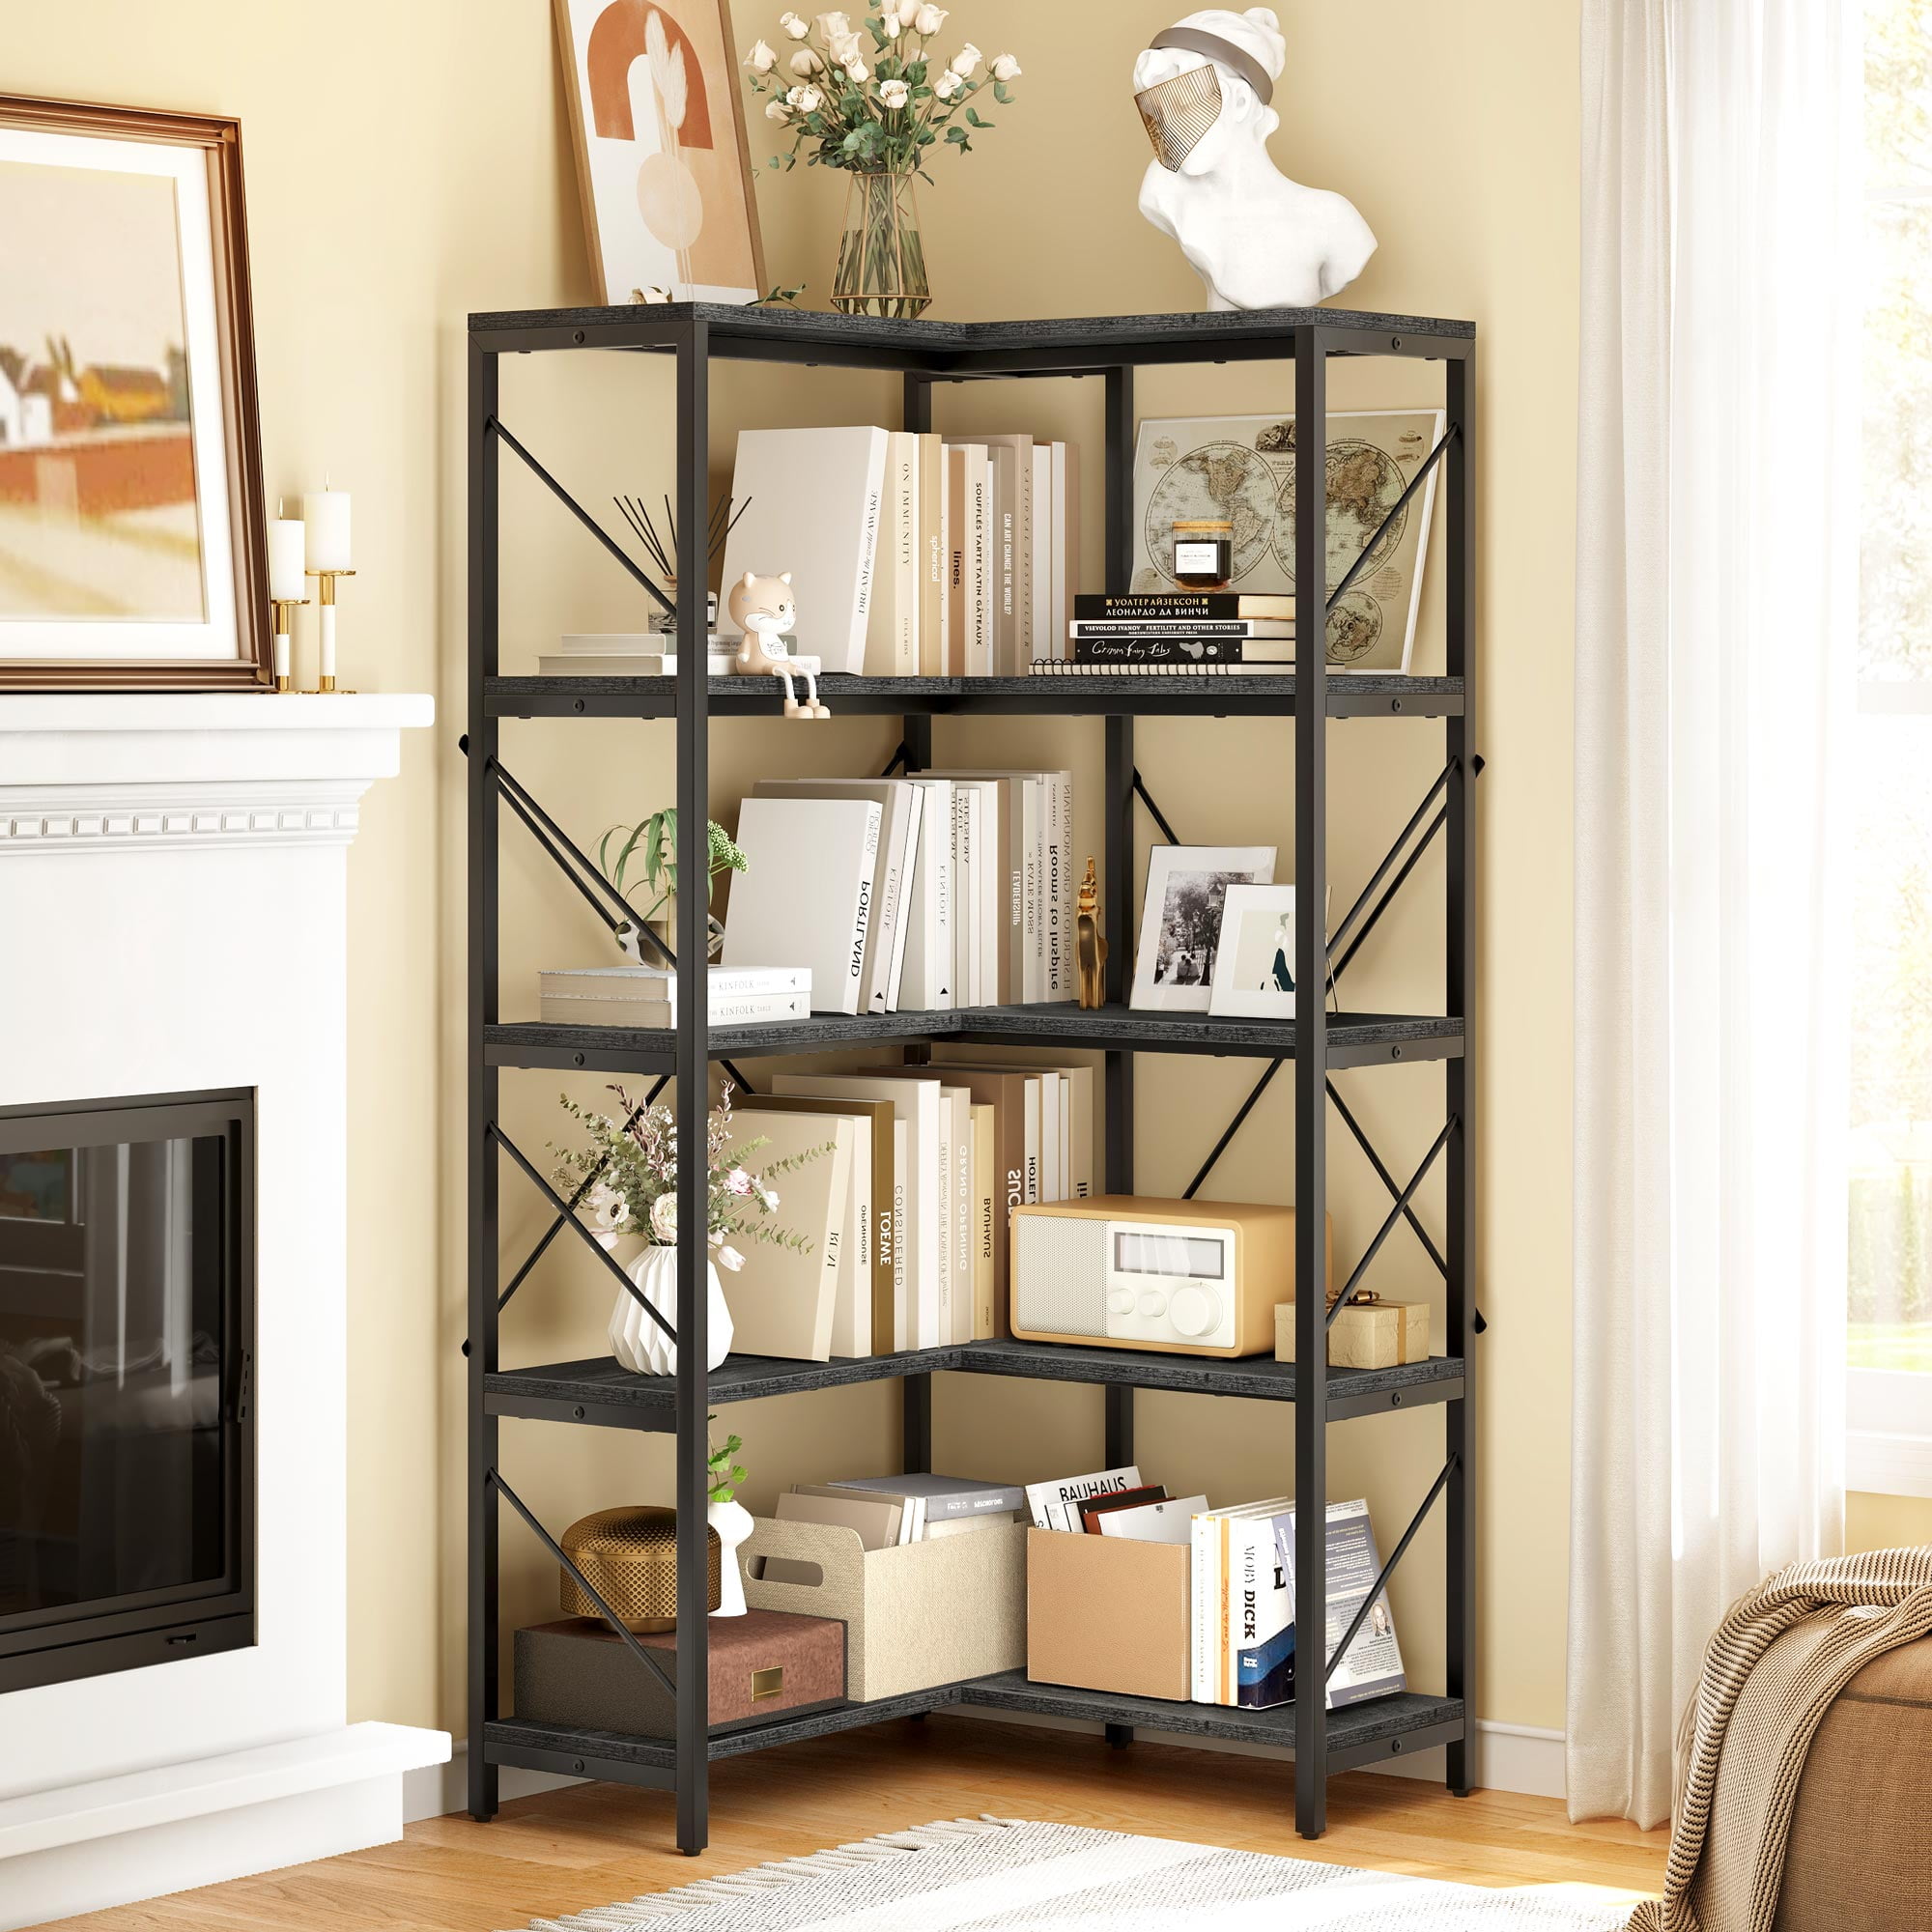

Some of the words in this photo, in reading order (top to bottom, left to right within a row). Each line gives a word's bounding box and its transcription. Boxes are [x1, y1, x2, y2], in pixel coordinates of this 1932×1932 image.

[902, 463, 910, 482] ON
[859, 570, 869, 614] DREAM
[867, 489, 877, 531] AWAKE
[930, 534, 940, 582] spherical
[953, 551, 962, 589] lines.
[1106, 608, 1156, 616] ЛЕОНАРДО
[1159, 608, 1172, 616] ДА
[720, 1005, 754, 1016] KINFOLK
[1059, 1476, 1127, 1502] BAUHAUS
[1244, 1545, 1255, 1583] MOBY
[1244, 1590, 1256, 1639] DICK
